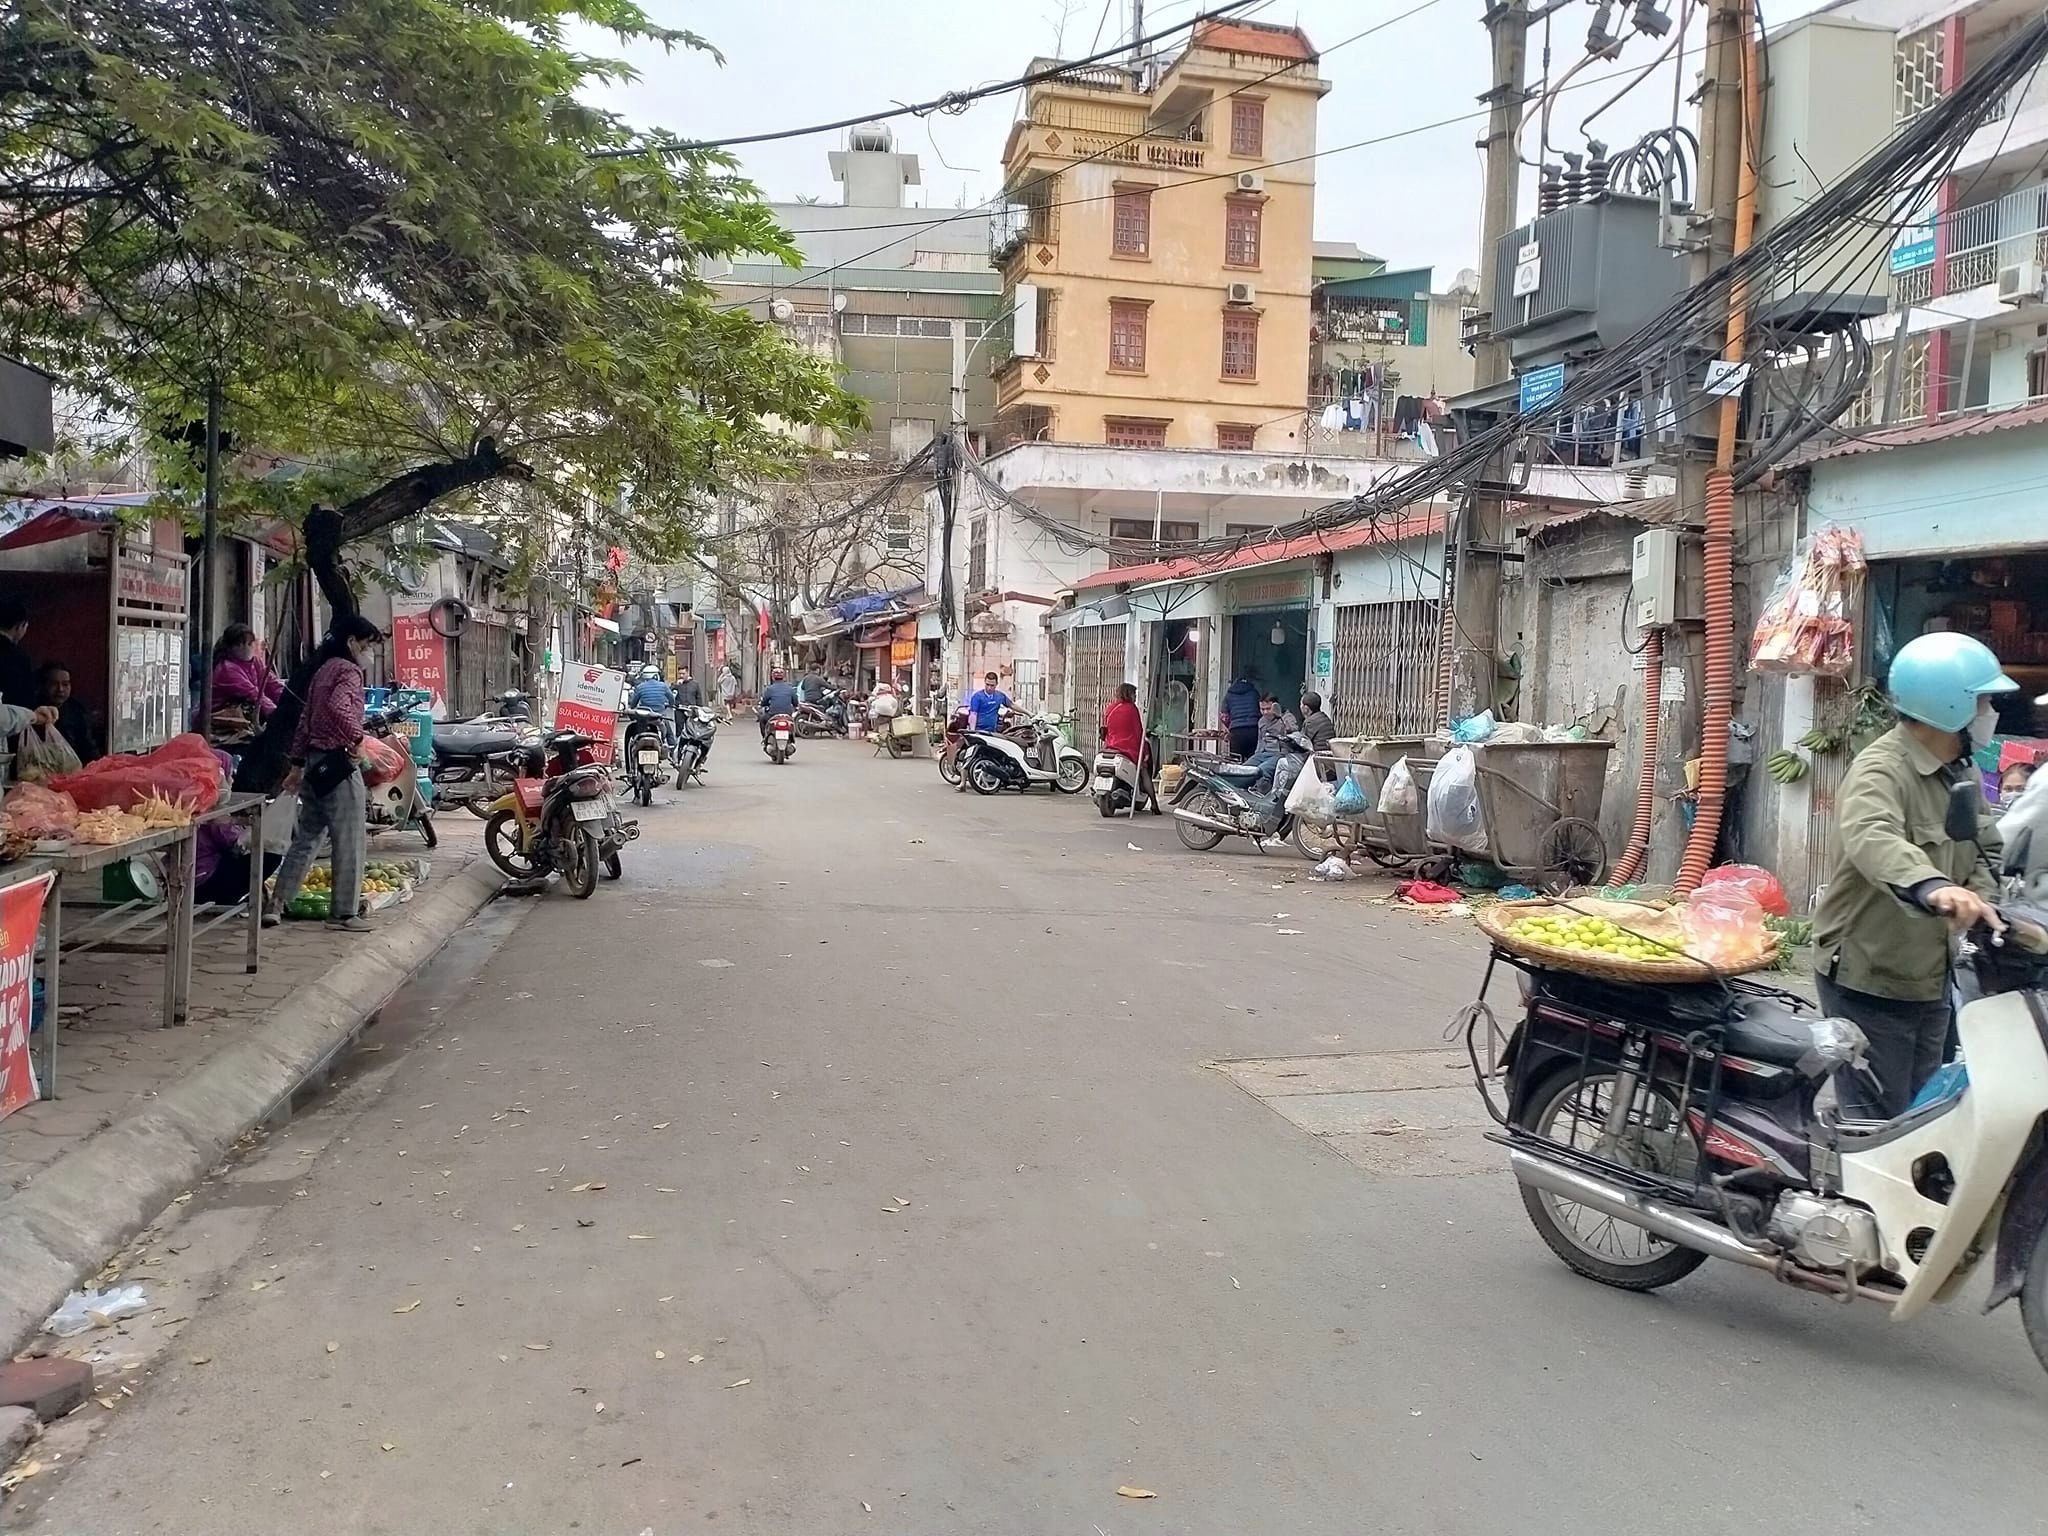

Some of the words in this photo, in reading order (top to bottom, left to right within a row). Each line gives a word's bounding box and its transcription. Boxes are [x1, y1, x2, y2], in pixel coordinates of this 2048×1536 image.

[405, 625, 433, 641] LÀM
[407, 644, 433, 660] LỐP
[402, 668, 419, 679] XE
[577, 682, 605, 694] idemitsu
[591, 714, 600, 723] XE
[600, 714, 614, 726] MÁY
